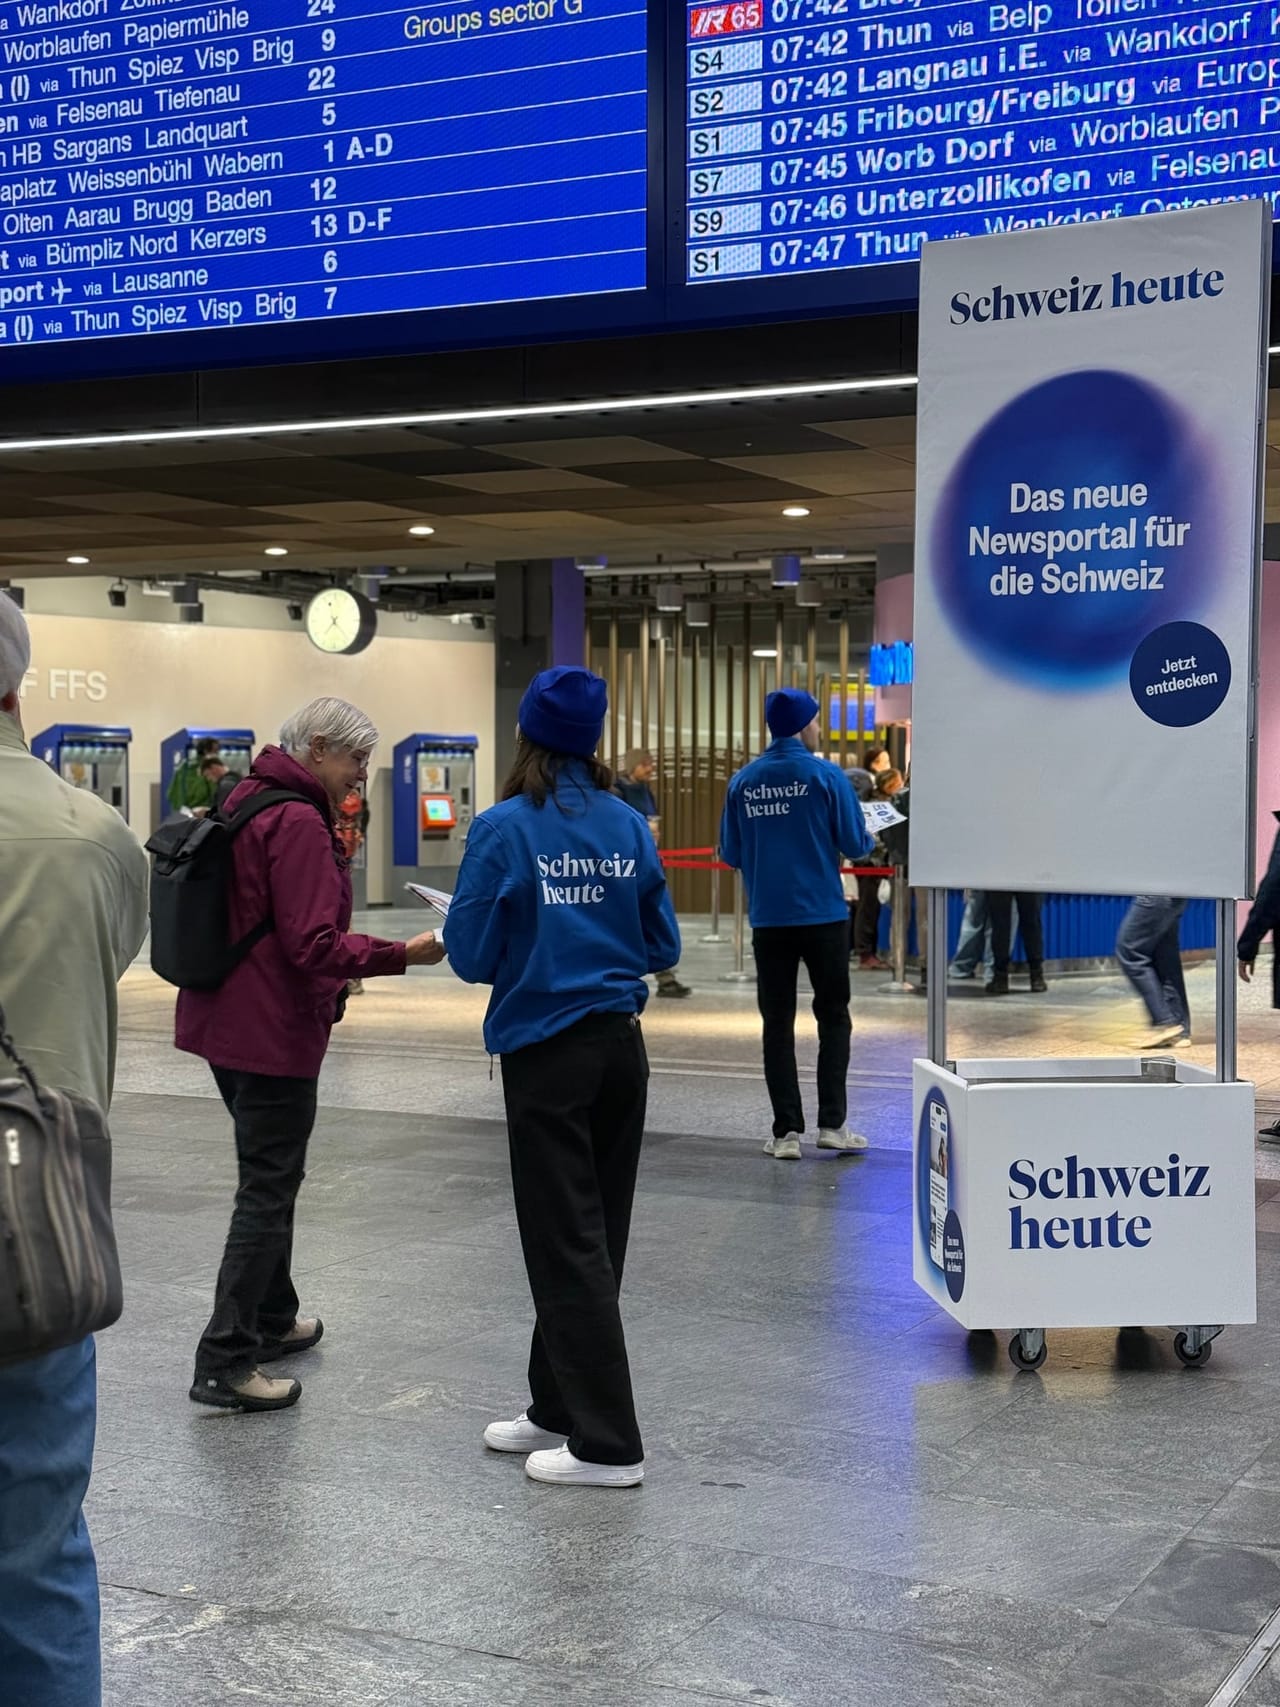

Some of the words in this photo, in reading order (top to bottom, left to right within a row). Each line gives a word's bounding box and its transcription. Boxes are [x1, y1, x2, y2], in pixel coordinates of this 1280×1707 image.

[4, 30, 111, 63] Worblaufen
[125, 9, 249, 46] Papiermühle
[307, 0, 335, 17] 24
[731, 4, 760, 28] 65
[771, 0, 848, 22] 07:42
[10, 74, 30, 101] (I)
[40, 80, 59, 93] via
[67, 66, 117, 89] Thun
[128, 56, 184, 84] Spiez
[195, 48, 239, 74] Visp
[253, 37, 294, 64] Brig
[321, 28, 336, 51] 9
[404, 11, 482, 38] Groups
[489, 0, 556, 27] sector
[695, 51, 724, 73] S4
[771, 30, 849, 63] 07:42
[858, 22, 932, 51] Thun
[947, 20, 974, 39] via
[988, 3, 1053, 32] Belp
[694, 91, 724, 114] S2
[771, 71, 848, 104] 07:42
[858, 55, 988, 93] Langnau
[999, 42, 1048, 73] i.E.
[1063, 46, 1092, 64] via
[1106, 12, 1252, 57] Wankdorf
[29, 114, 48, 129] via
[57, 96, 142, 126] Felsenau
[155, 83, 240, 112] Tiefenau
[307, 66, 336, 91] 22
[694, 132, 721, 154] S1
[771, 112, 848, 145] 07:45
[858, 77, 1136, 134] Fribourg/Freiburg
[1152, 76, 1182, 94] via
[13, 143, 41, 167] HB
[54, 134, 132, 162] Sargans
[145, 116, 248, 150] Landquart
[321, 103, 336, 126] 5
[694, 172, 723, 194] S7
[770, 153, 848, 186] 07:45
[857, 143, 935, 175] Worb
[946, 131, 1015, 164] Dorf
[1029, 137, 1057, 154] via
[1071, 106, 1239, 147] Worblaufen
[68, 158, 192, 194] Weissenbühl
[204, 152, 283, 178] Wabern
[323, 140, 334, 162] 1
[346, 132, 393, 160] A-D
[4, 213, 53, 236] Olten
[64, 205, 121, 229] Aarau
[133, 196, 193, 223] Brugg
[206, 188, 272, 214] Baden
[310, 176, 337, 201] 12
[694, 211, 723, 233] S9
[770, 194, 847, 227] 07:46
[856, 169, 1091, 216] Unterzollikofen
[1107, 169, 1135, 187] via
[18, 255, 37, 268] via
[47, 238, 123, 266] Bümpliz
[130, 232, 177, 256] Nord
[191, 224, 266, 251] Kerzers
[310, 213, 337, 237] 13
[348, 207, 393, 234] D-F
[694, 252, 721, 272] S1
[769, 234, 846, 267] 07:47
[855, 231, 928, 258] Thun
[83, 282, 102, 296] via
[112, 268, 208, 293] Lausanne
[323, 249, 338, 273] 6
[950, 276, 1103, 325] Schweiz
[1111, 267, 1225, 308] heute
[14, 315, 33, 341] (I)
[44, 321, 63, 334] via
[71, 311, 119, 332] Thun
[132, 305, 187, 330] Spiez
[199, 299, 242, 324] Visp
[256, 292, 296, 319] Brig
[323, 286, 338, 309] 7
[1010, 482, 1065, 513] Das
[1073, 482, 1148, 511] neue
[969, 518, 1137, 560] Newsportal
[1144, 516, 1191, 547] für
[990, 566, 1034, 596] die
[1041, 560, 1164, 594] Schweiz
[49, 668, 107, 701] FFS
[1145, 672, 1219, 696] entdecken
[1161, 655, 1198, 675] Jetzt
[743, 780, 809, 802] Schweiz
[745, 801, 791, 819] heute
[537, 852, 637, 878] Schweiz
[541, 879, 605, 905] heute
[1008, 1153, 1211, 1200] Schweiz
[1008, 1205, 1152, 1250] heute
